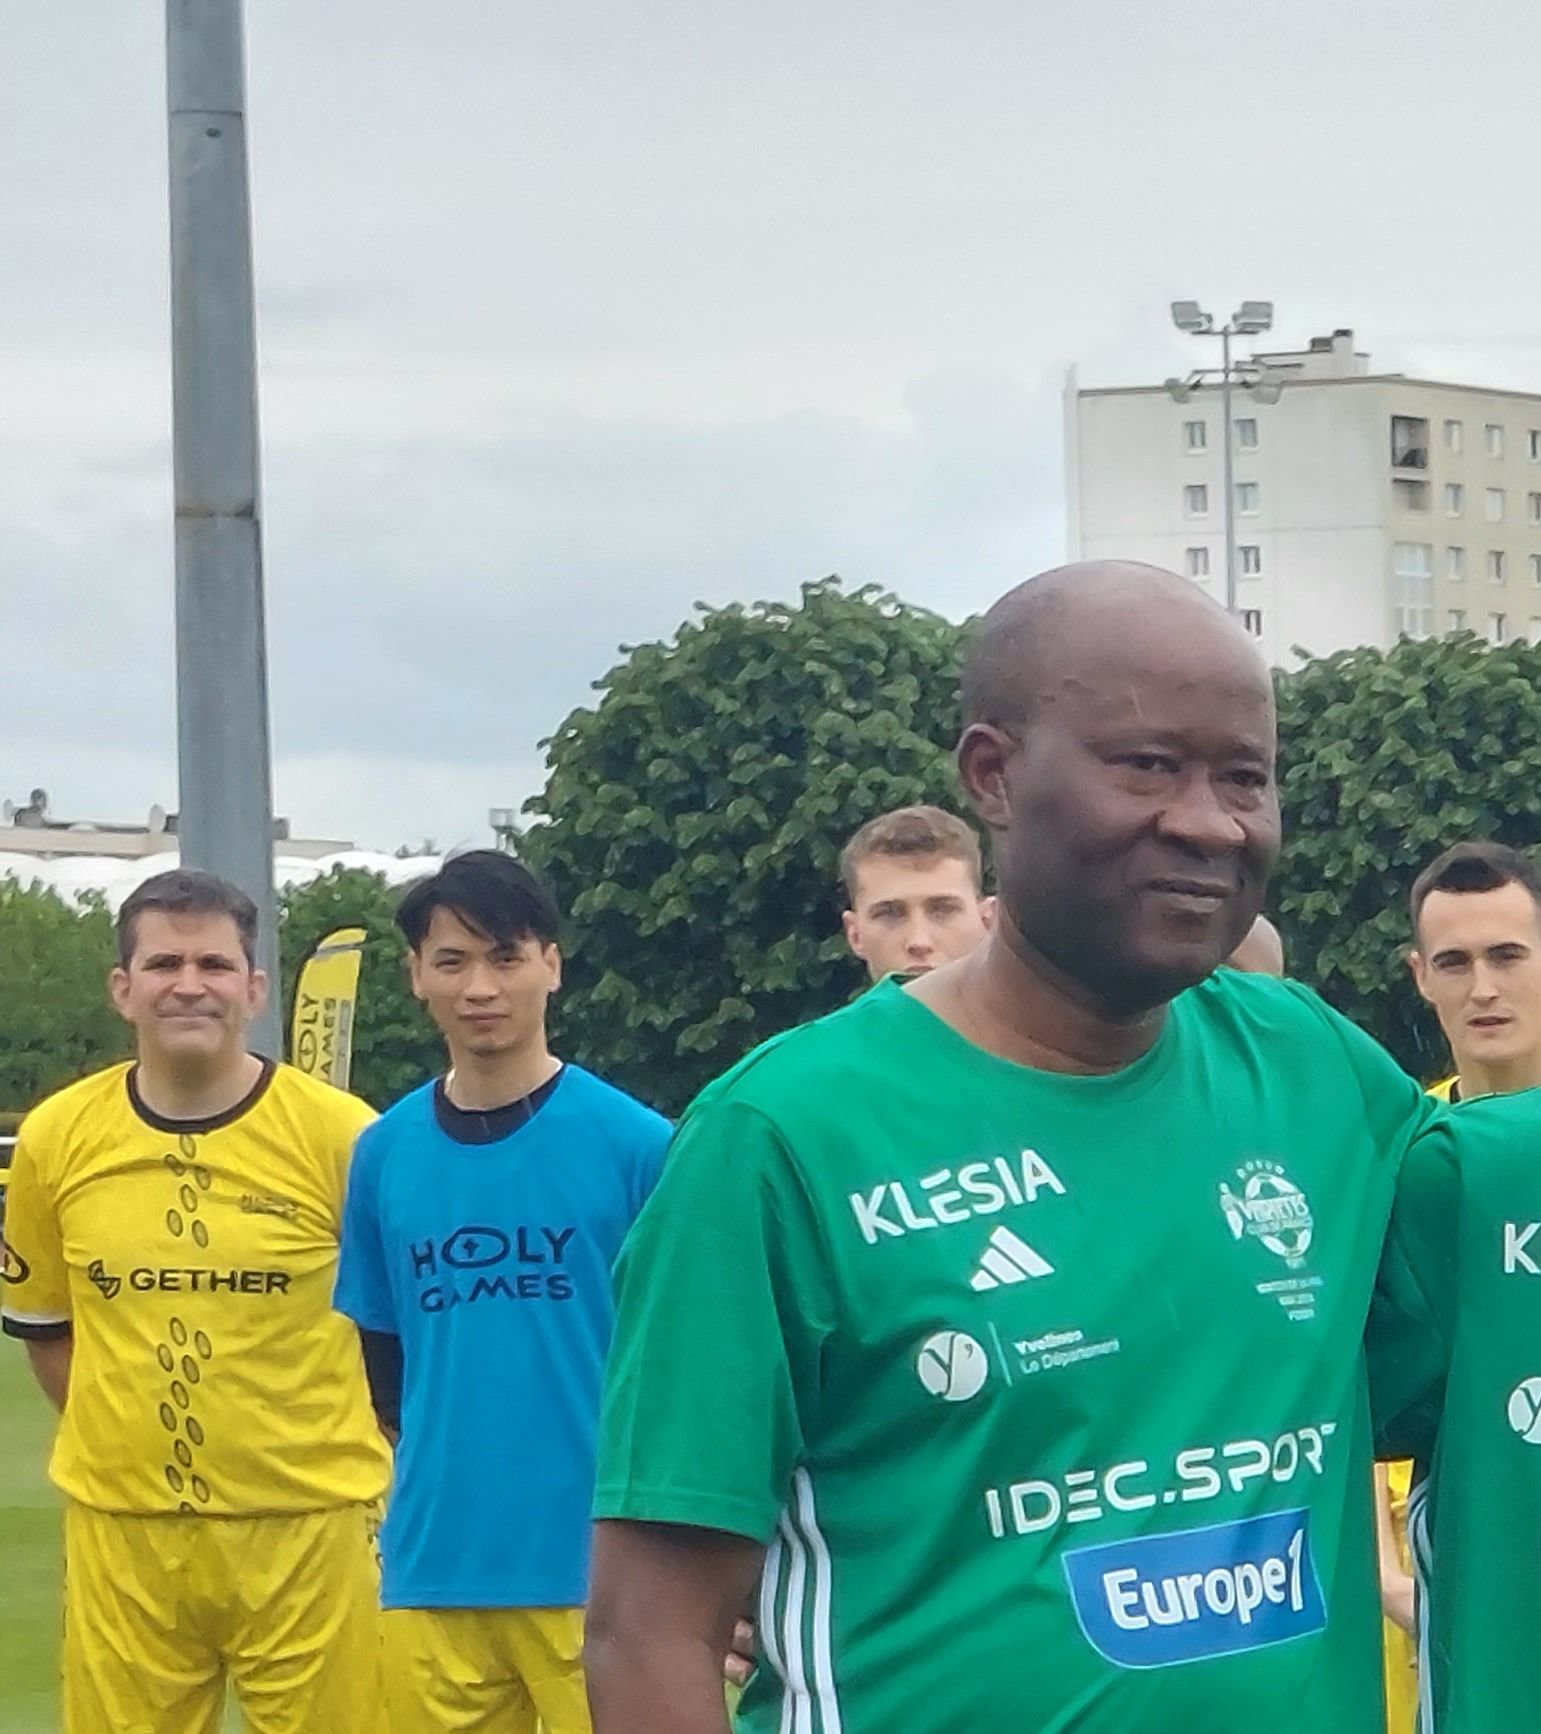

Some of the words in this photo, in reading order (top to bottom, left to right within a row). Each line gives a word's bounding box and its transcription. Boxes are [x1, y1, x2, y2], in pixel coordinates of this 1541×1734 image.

[409, 1225, 576, 1280] HOLY
[129, 1268, 292, 1294] GETHER
[984, 1423, 1337, 1539] IDEC.SPORT
